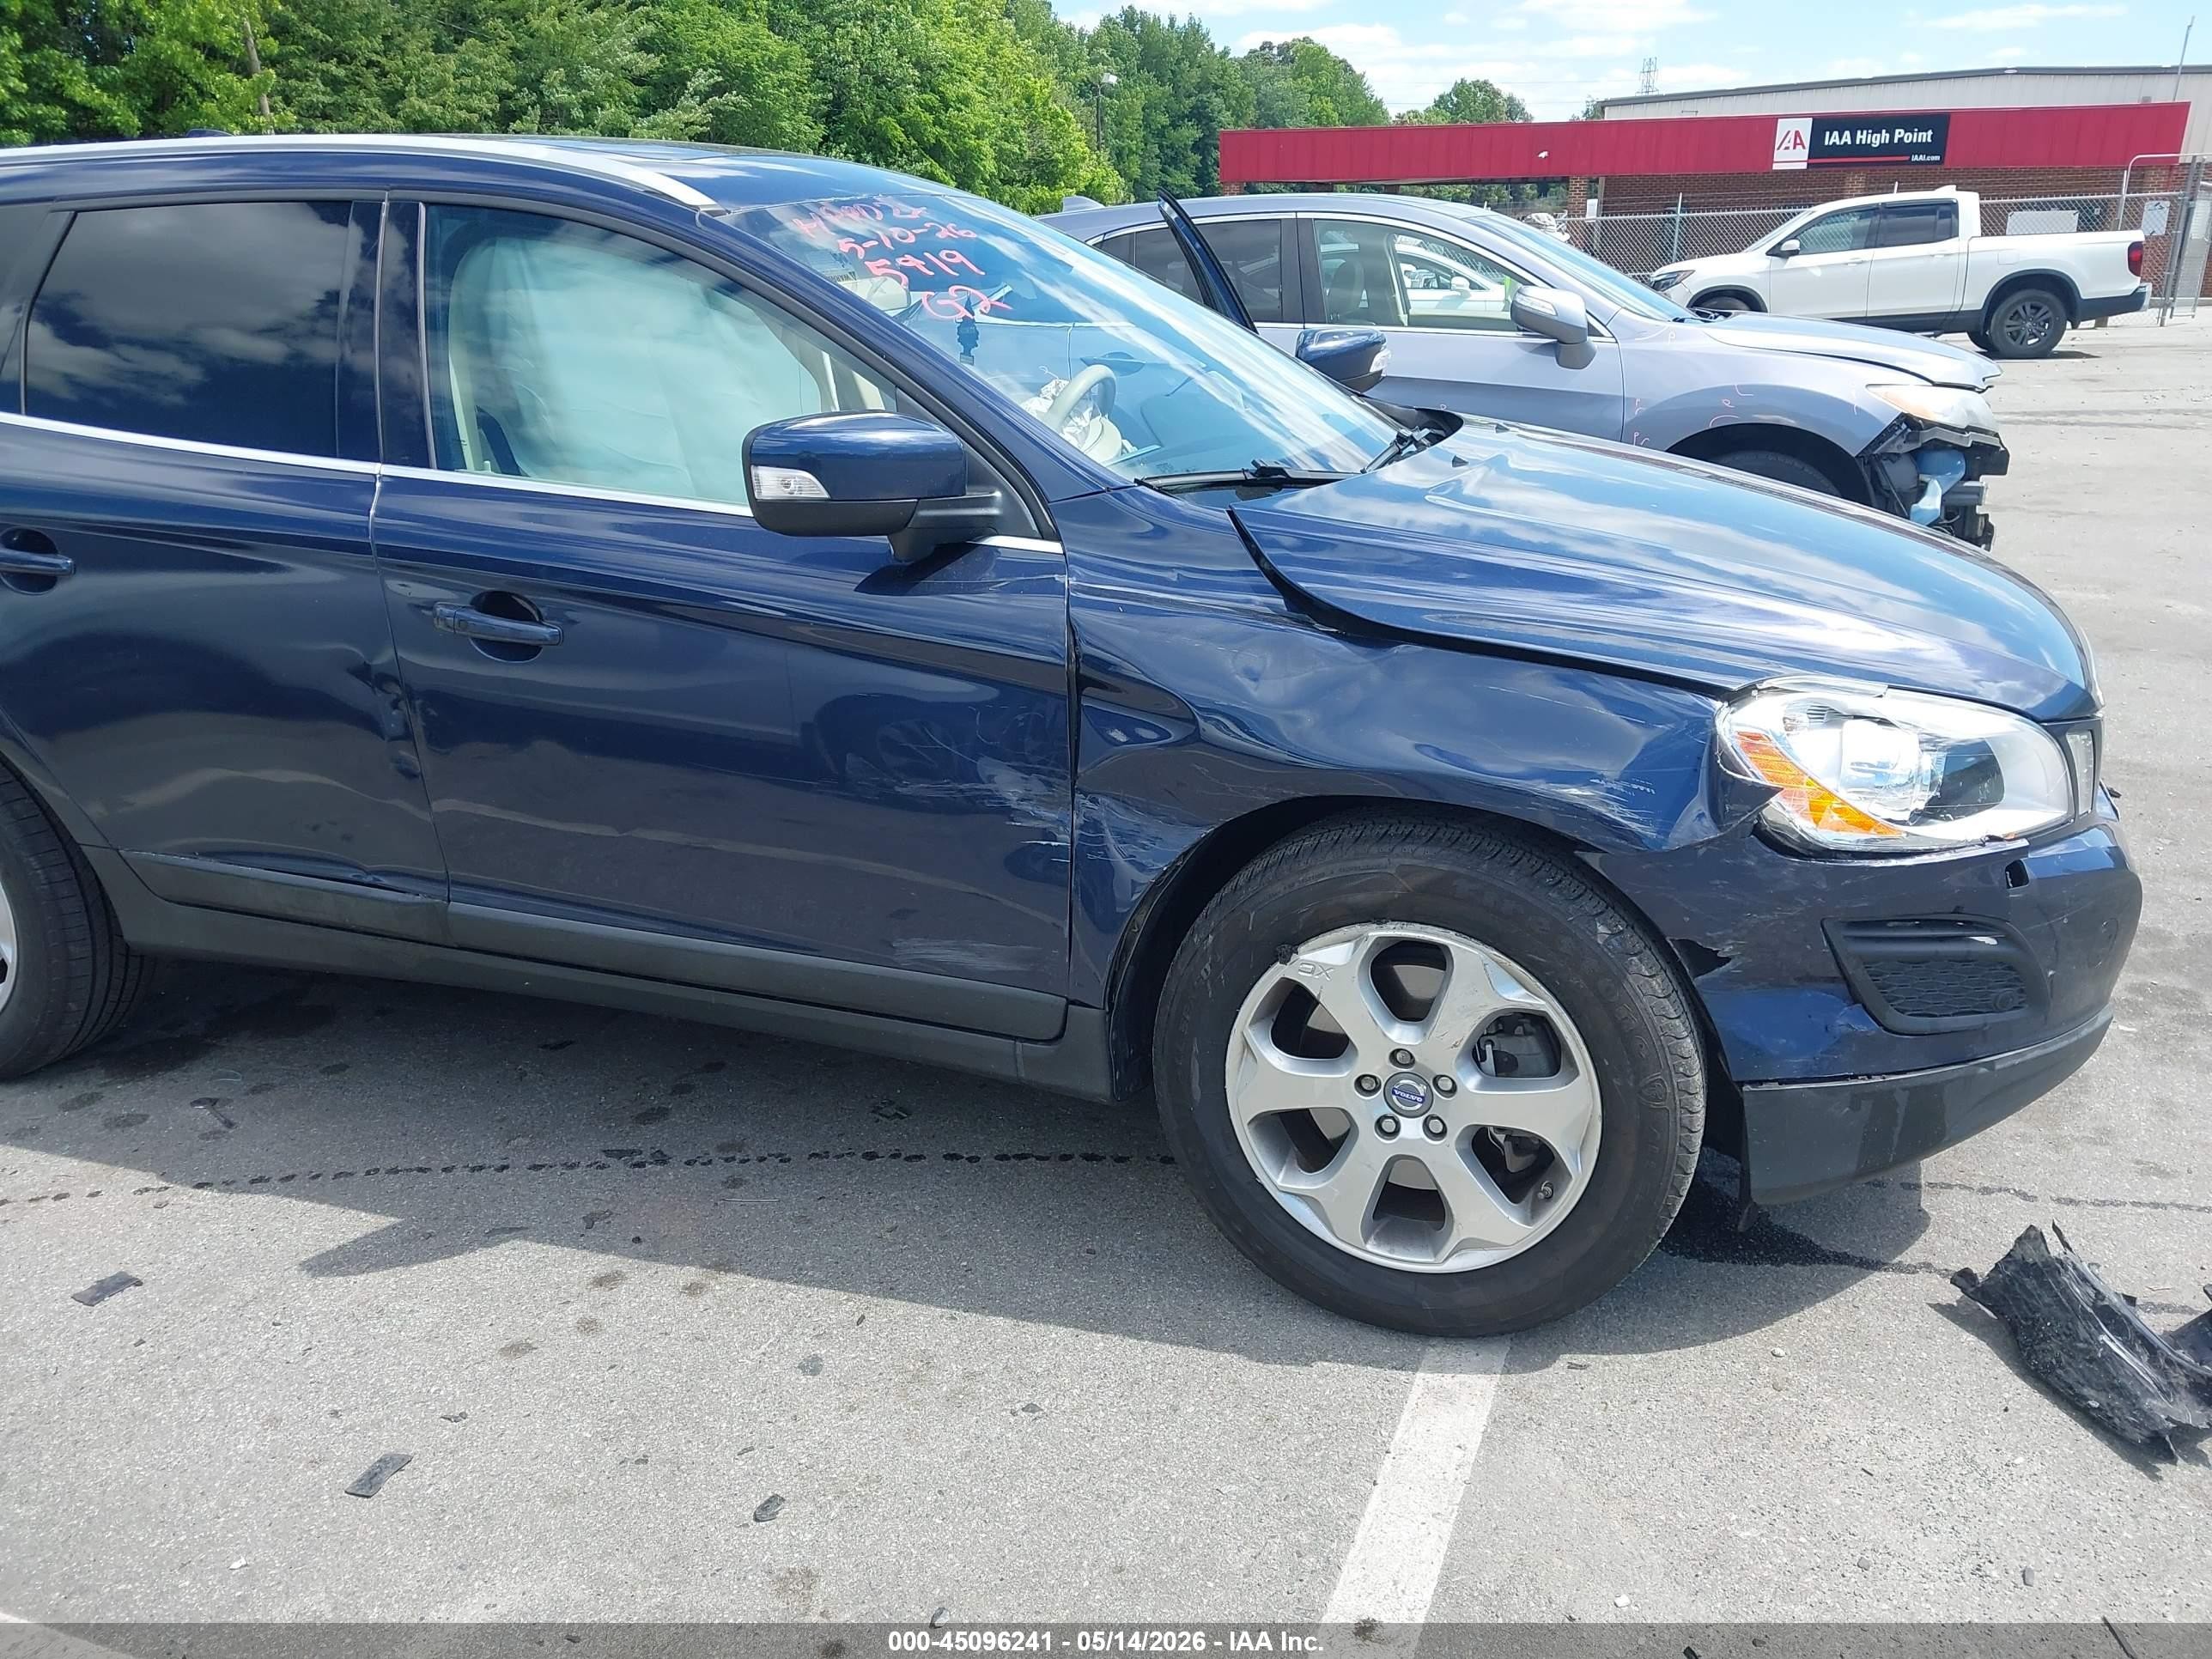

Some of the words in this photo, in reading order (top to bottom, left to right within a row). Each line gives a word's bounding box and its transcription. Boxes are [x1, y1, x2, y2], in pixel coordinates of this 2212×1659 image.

[1824, 131, 1851, 146] IAA
[1856, 130, 1889, 147] High
[1893, 128, 1933, 144] Point
[1393, 1088, 1423, 1103] VOLVO
